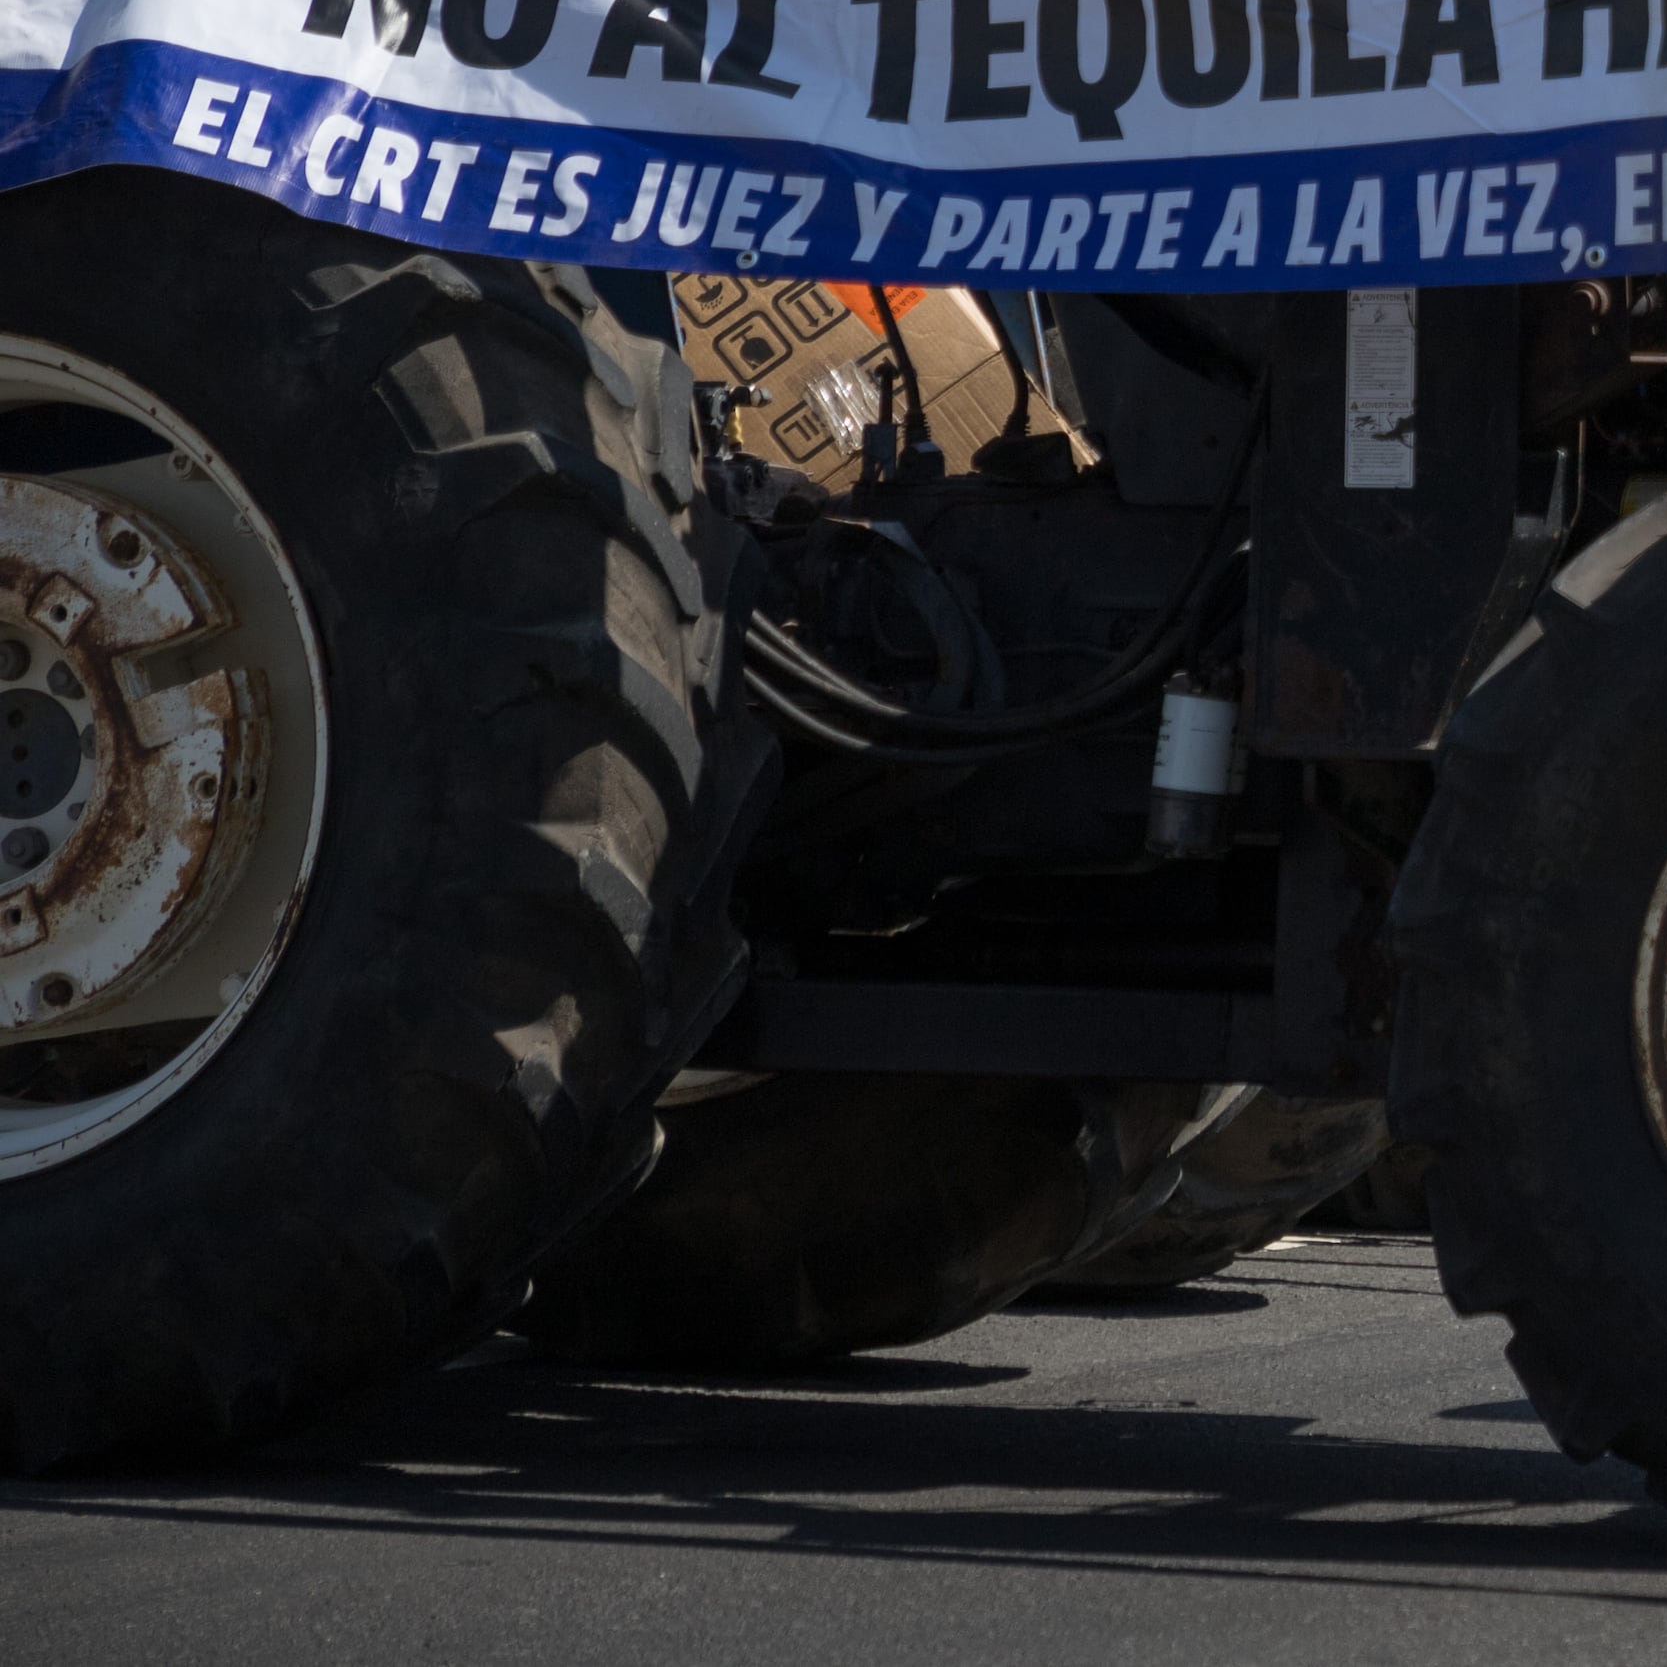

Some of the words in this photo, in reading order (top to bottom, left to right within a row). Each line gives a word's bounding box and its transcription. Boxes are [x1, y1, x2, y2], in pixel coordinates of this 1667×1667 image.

[172, 77, 273, 170] EL
[304, 112, 482, 222] CRT
[489, 149, 602, 238] ES
[610, 165, 831, 258] JUEZ
[851, 183, 914, 264] Y
[918, 187, 1193, 273] PARTE
[1203, 186, 1263, 270] A
[1284, 177, 1386, 267] LA
[1417, 162, 1586, 275] VEZ,
